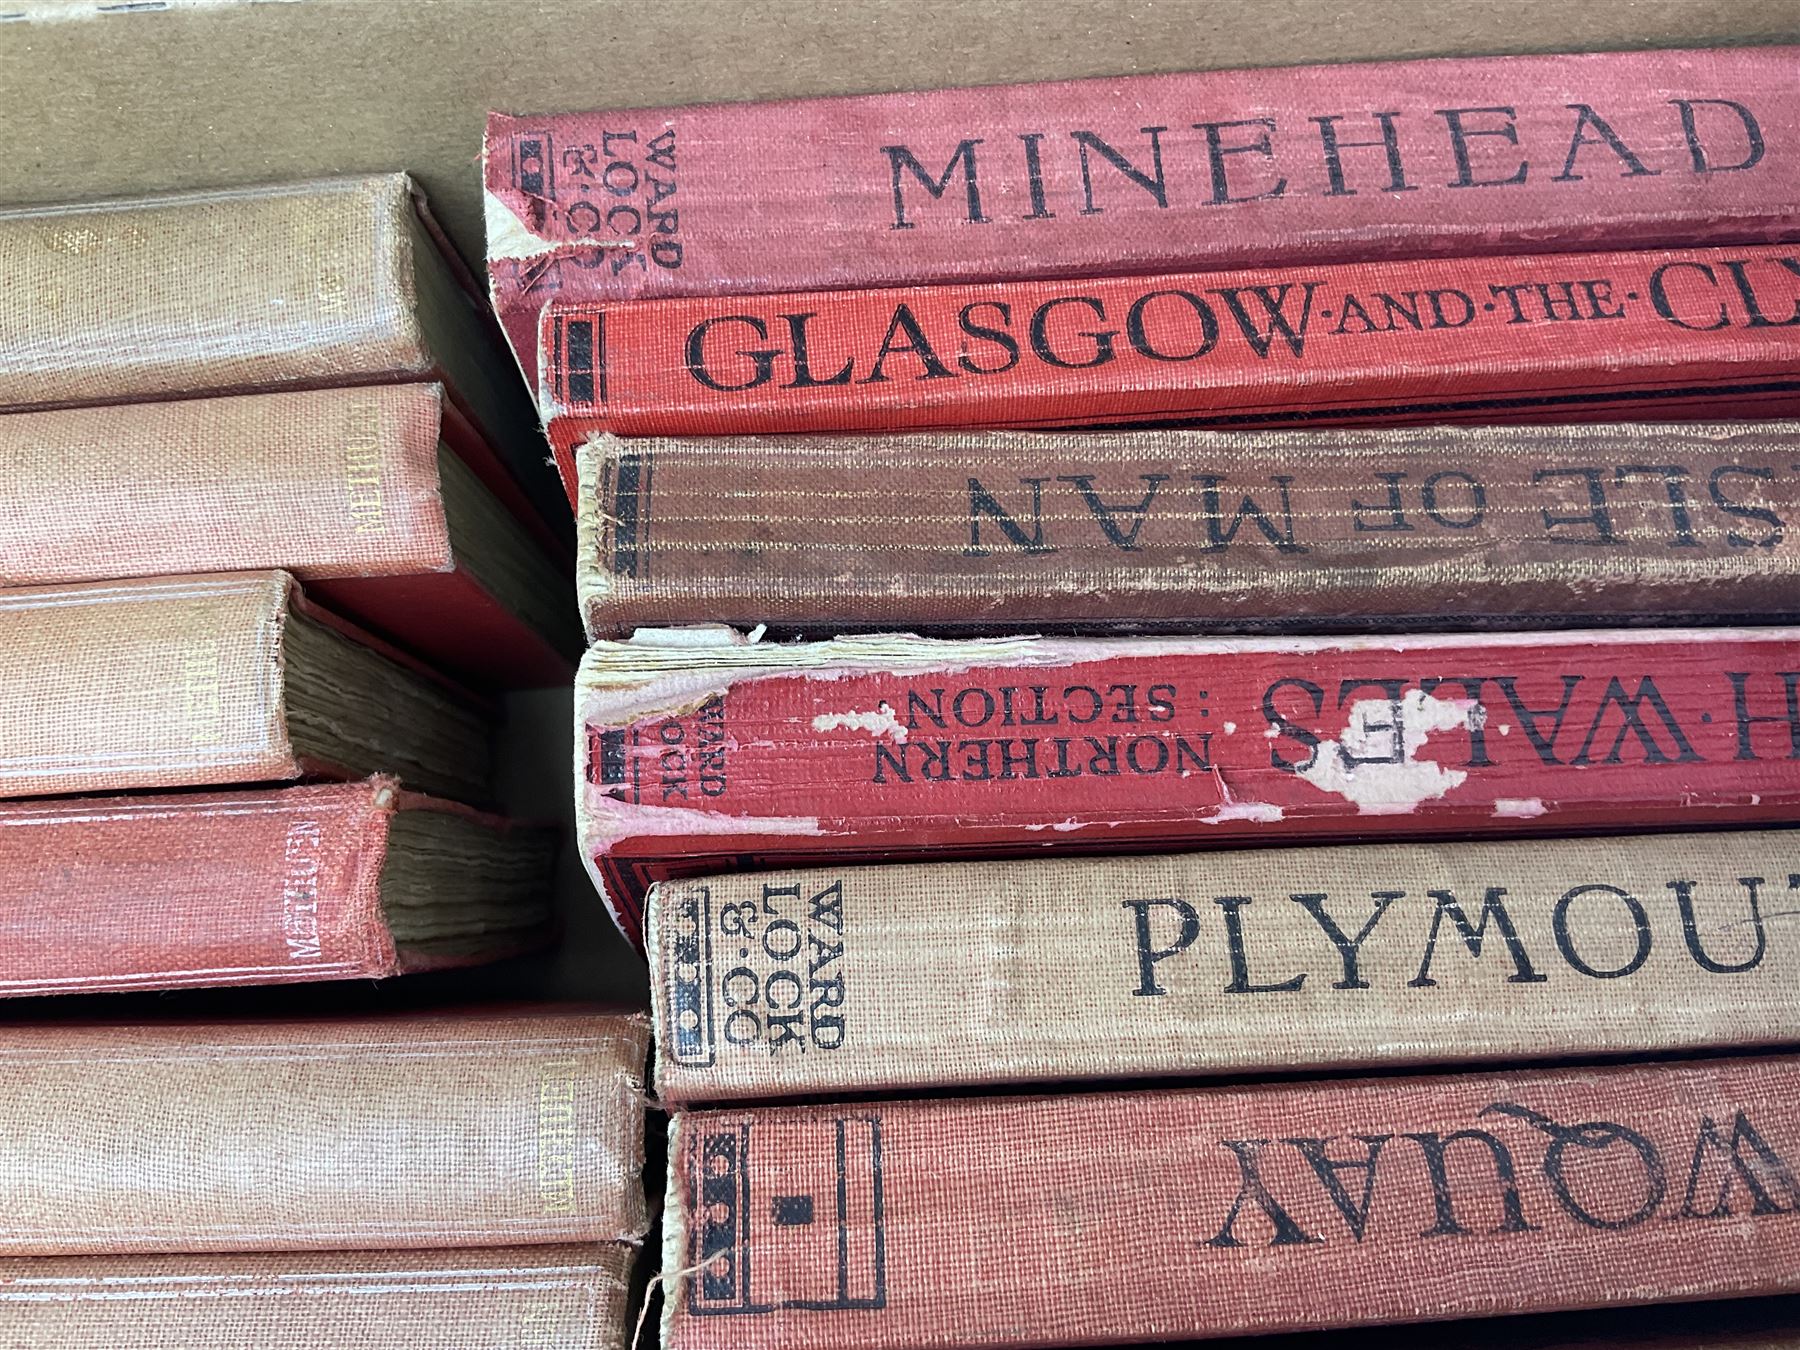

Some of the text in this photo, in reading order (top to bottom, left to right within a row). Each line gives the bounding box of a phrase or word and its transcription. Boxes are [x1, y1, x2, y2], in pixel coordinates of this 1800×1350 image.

[603, 129, 648, 277] LOCK
[645, 130, 684, 270] WARD
[880, 98, 1764, 230] MINEHEAD
[684, 280, 1327, 393] GLASGOW
[1328, 287, 1477, 335] AND
[1488, 280, 1627, 325] THE
[962, 463, 1800, 559] SLE OF MAN
[659, 721, 690, 801] OCK
[697, 696, 727, 797] WARD
[871, 731, 1212, 785] NORTHERN
[906, 682, 1177, 731] SECTION
[1261, 674, 1706, 774] WALES
[283, 821, 321, 958] METHUEN
[1122, 873, 1800, 997] PLYMOU
[762, 882, 806, 1057] LOCK
[807, 880, 846, 1051] WARD
[1201, 1101, 1800, 1248] WQUAY
